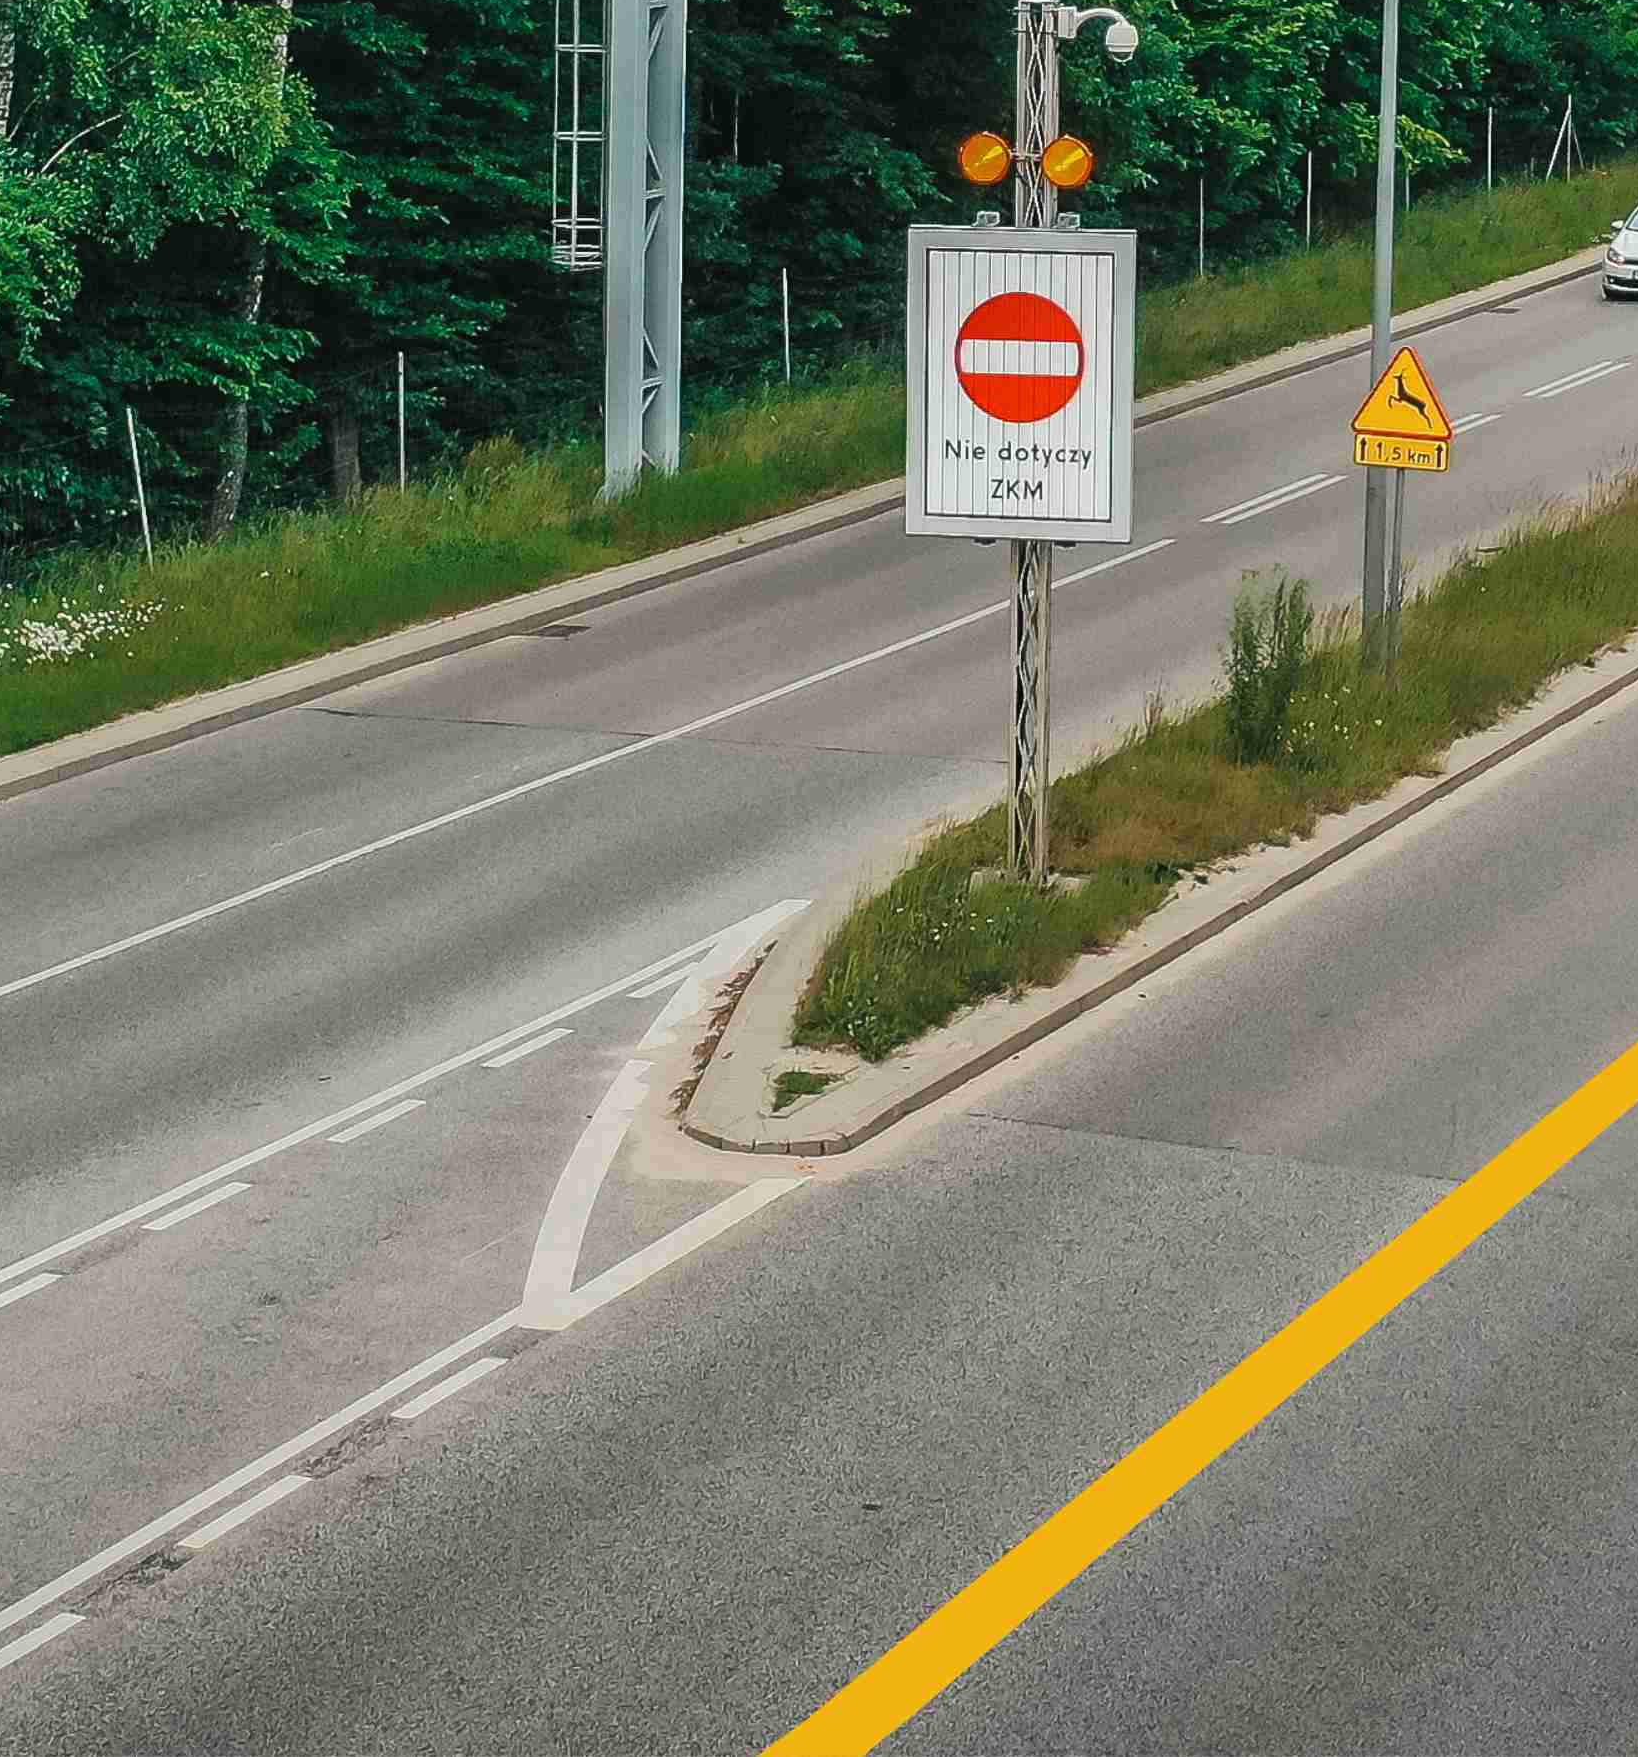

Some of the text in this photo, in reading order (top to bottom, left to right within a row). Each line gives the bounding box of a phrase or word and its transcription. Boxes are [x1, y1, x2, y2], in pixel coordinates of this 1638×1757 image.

[945, 439, 1092, 470] Nie dotyczy
[1376, 441, 1430, 464] 1,5 km
[991, 478, 1043, 500] ZKM
